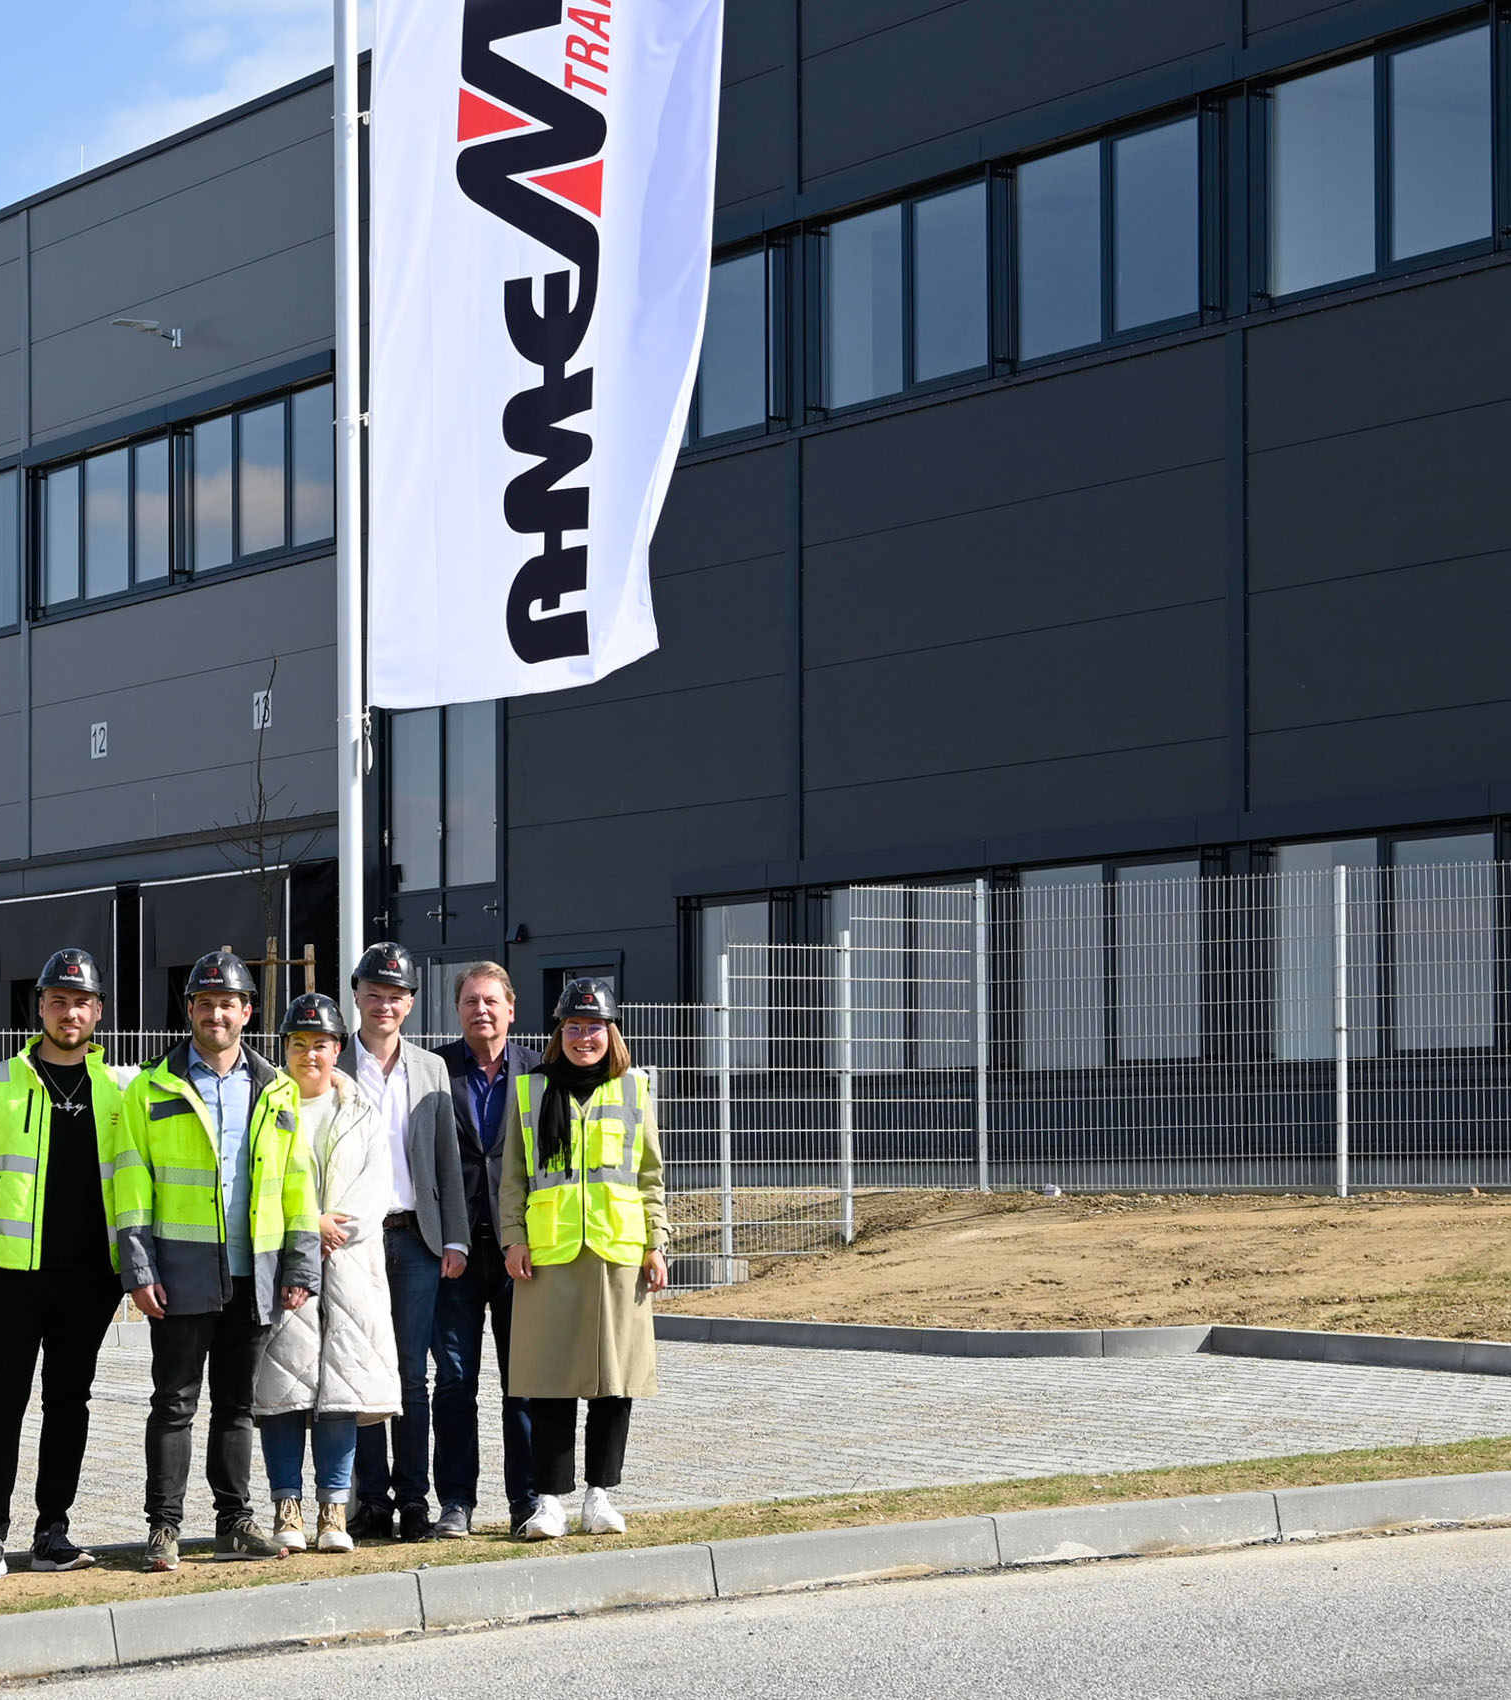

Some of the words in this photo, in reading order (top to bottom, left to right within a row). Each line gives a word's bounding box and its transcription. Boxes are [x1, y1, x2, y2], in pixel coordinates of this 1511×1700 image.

[564, 0, 612, 97] TRA
[255, 695, 270, 724] 13
[92, 726, 106, 754] 12
